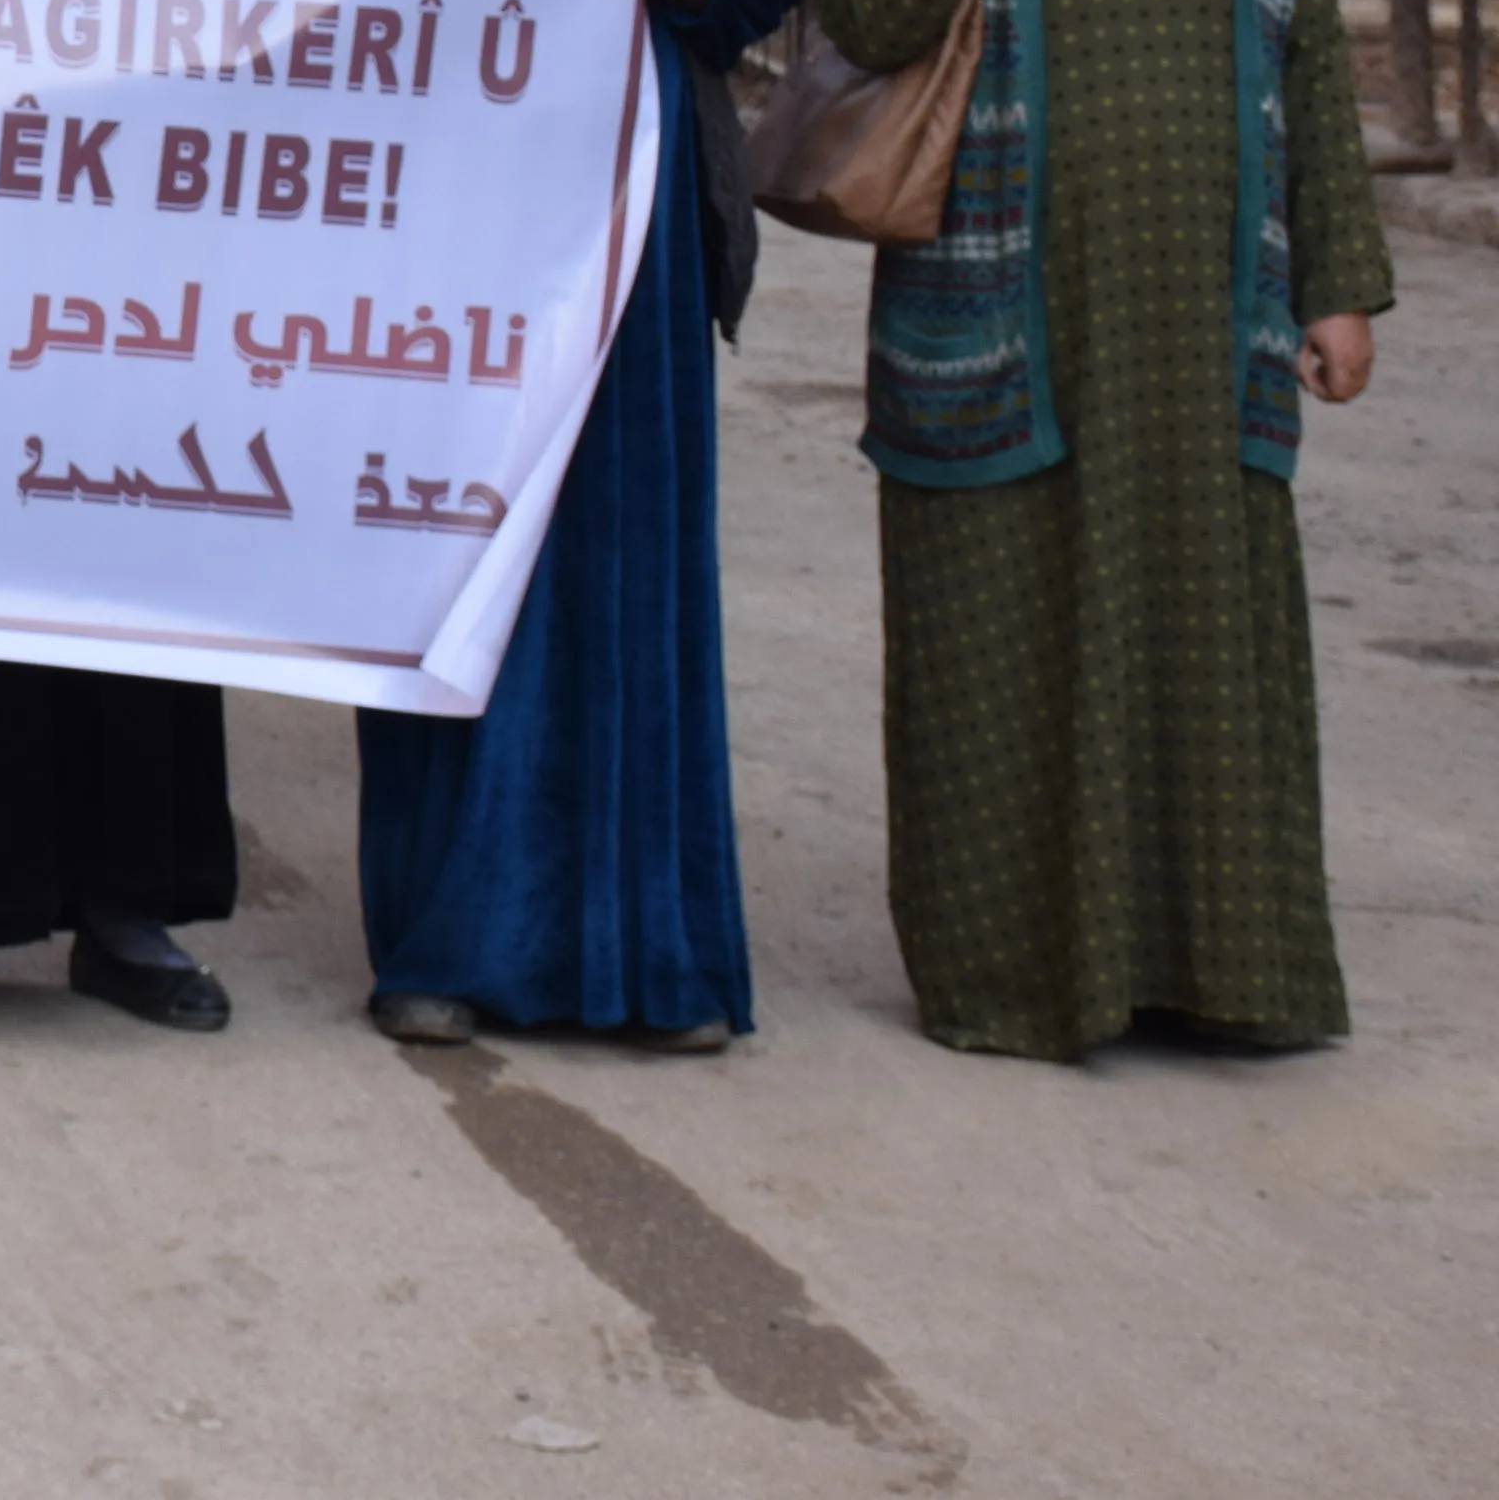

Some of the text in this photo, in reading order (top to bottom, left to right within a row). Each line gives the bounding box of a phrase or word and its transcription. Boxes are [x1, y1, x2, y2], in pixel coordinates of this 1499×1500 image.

[156, 126, 404, 229] BIBE!
[9, 282, 201, 370] لدحر
[233, 296, 526, 388] ناضلي
